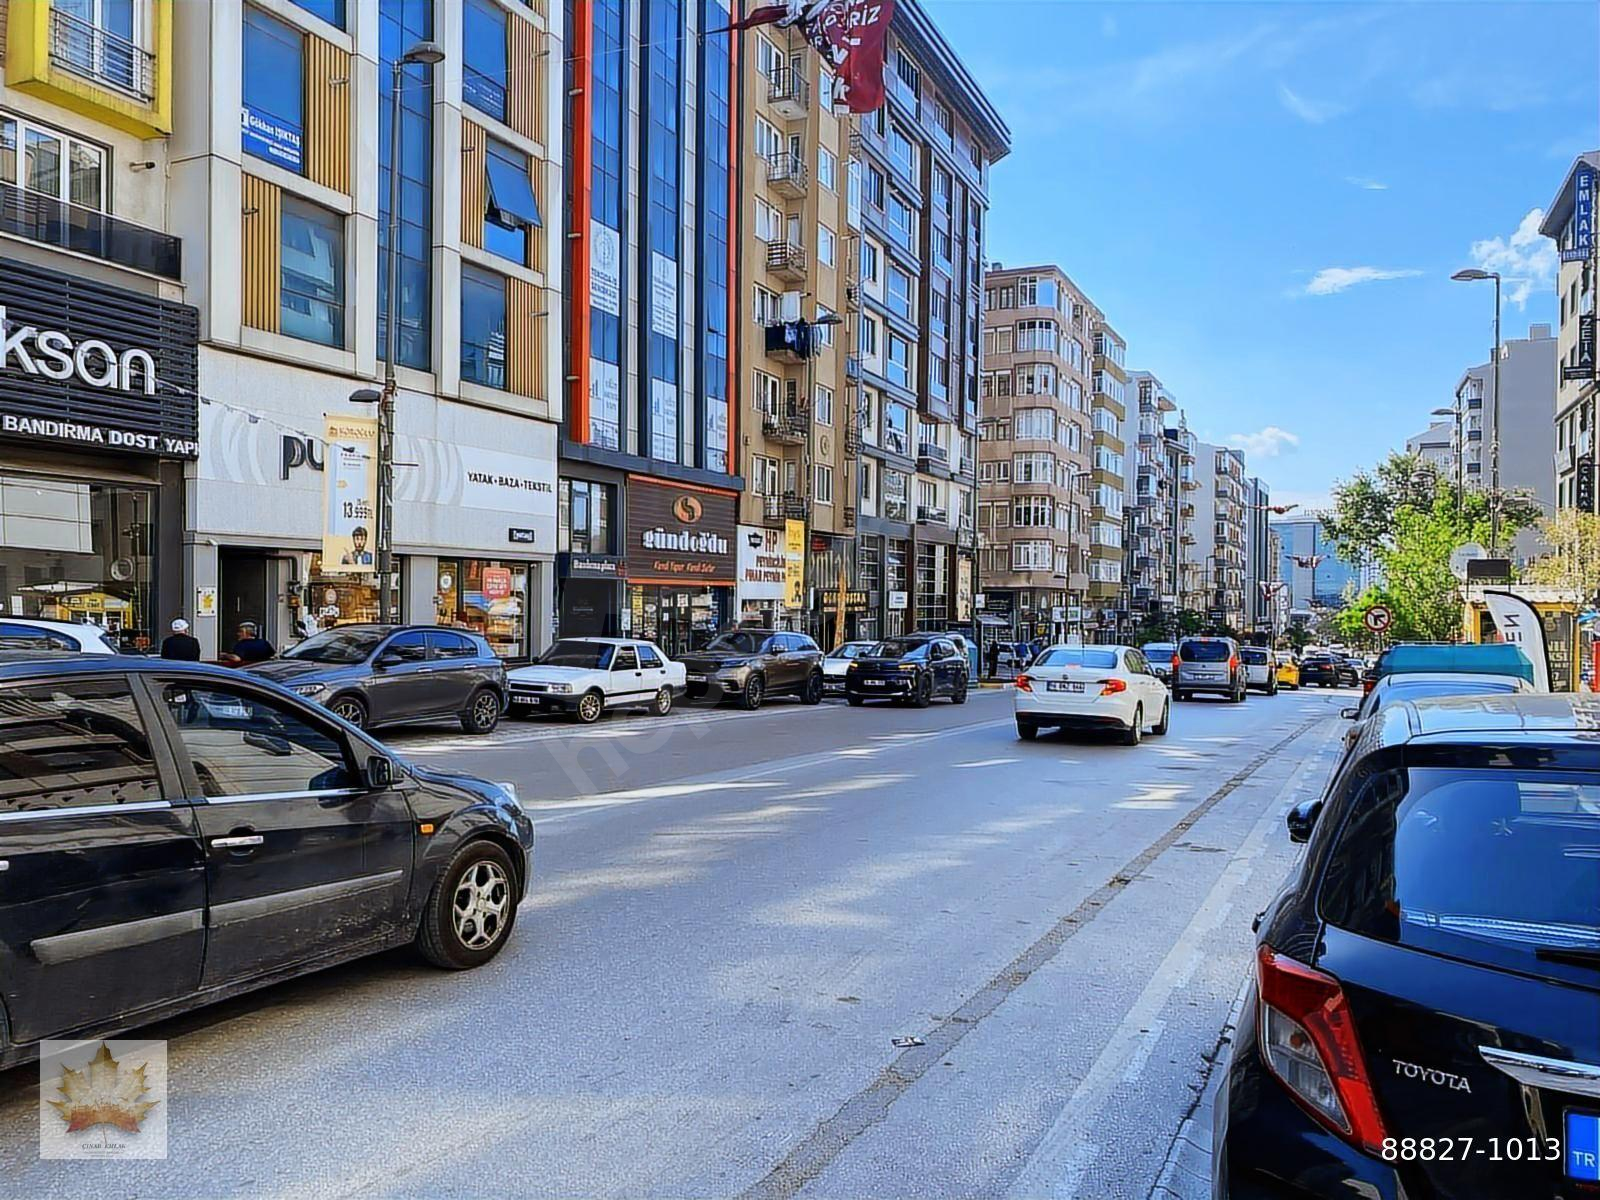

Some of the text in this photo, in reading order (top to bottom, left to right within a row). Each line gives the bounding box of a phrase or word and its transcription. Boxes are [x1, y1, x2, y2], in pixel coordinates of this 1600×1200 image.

[1578, 174, 1590, 247] EMLAK
[1580, 317, 1592, 363] ZETA
[3, 414, 199, 456] BANDIRMA DOST YAPI
[467, 471, 493, 485] YATAK
[498, 475, 520, 489] BAZA
[642, 526, 728, 555] gündoğdu
[1392, 1058, 1473, 1094] TOYOTA
[1572, 1150, 1596, 1168] TR
